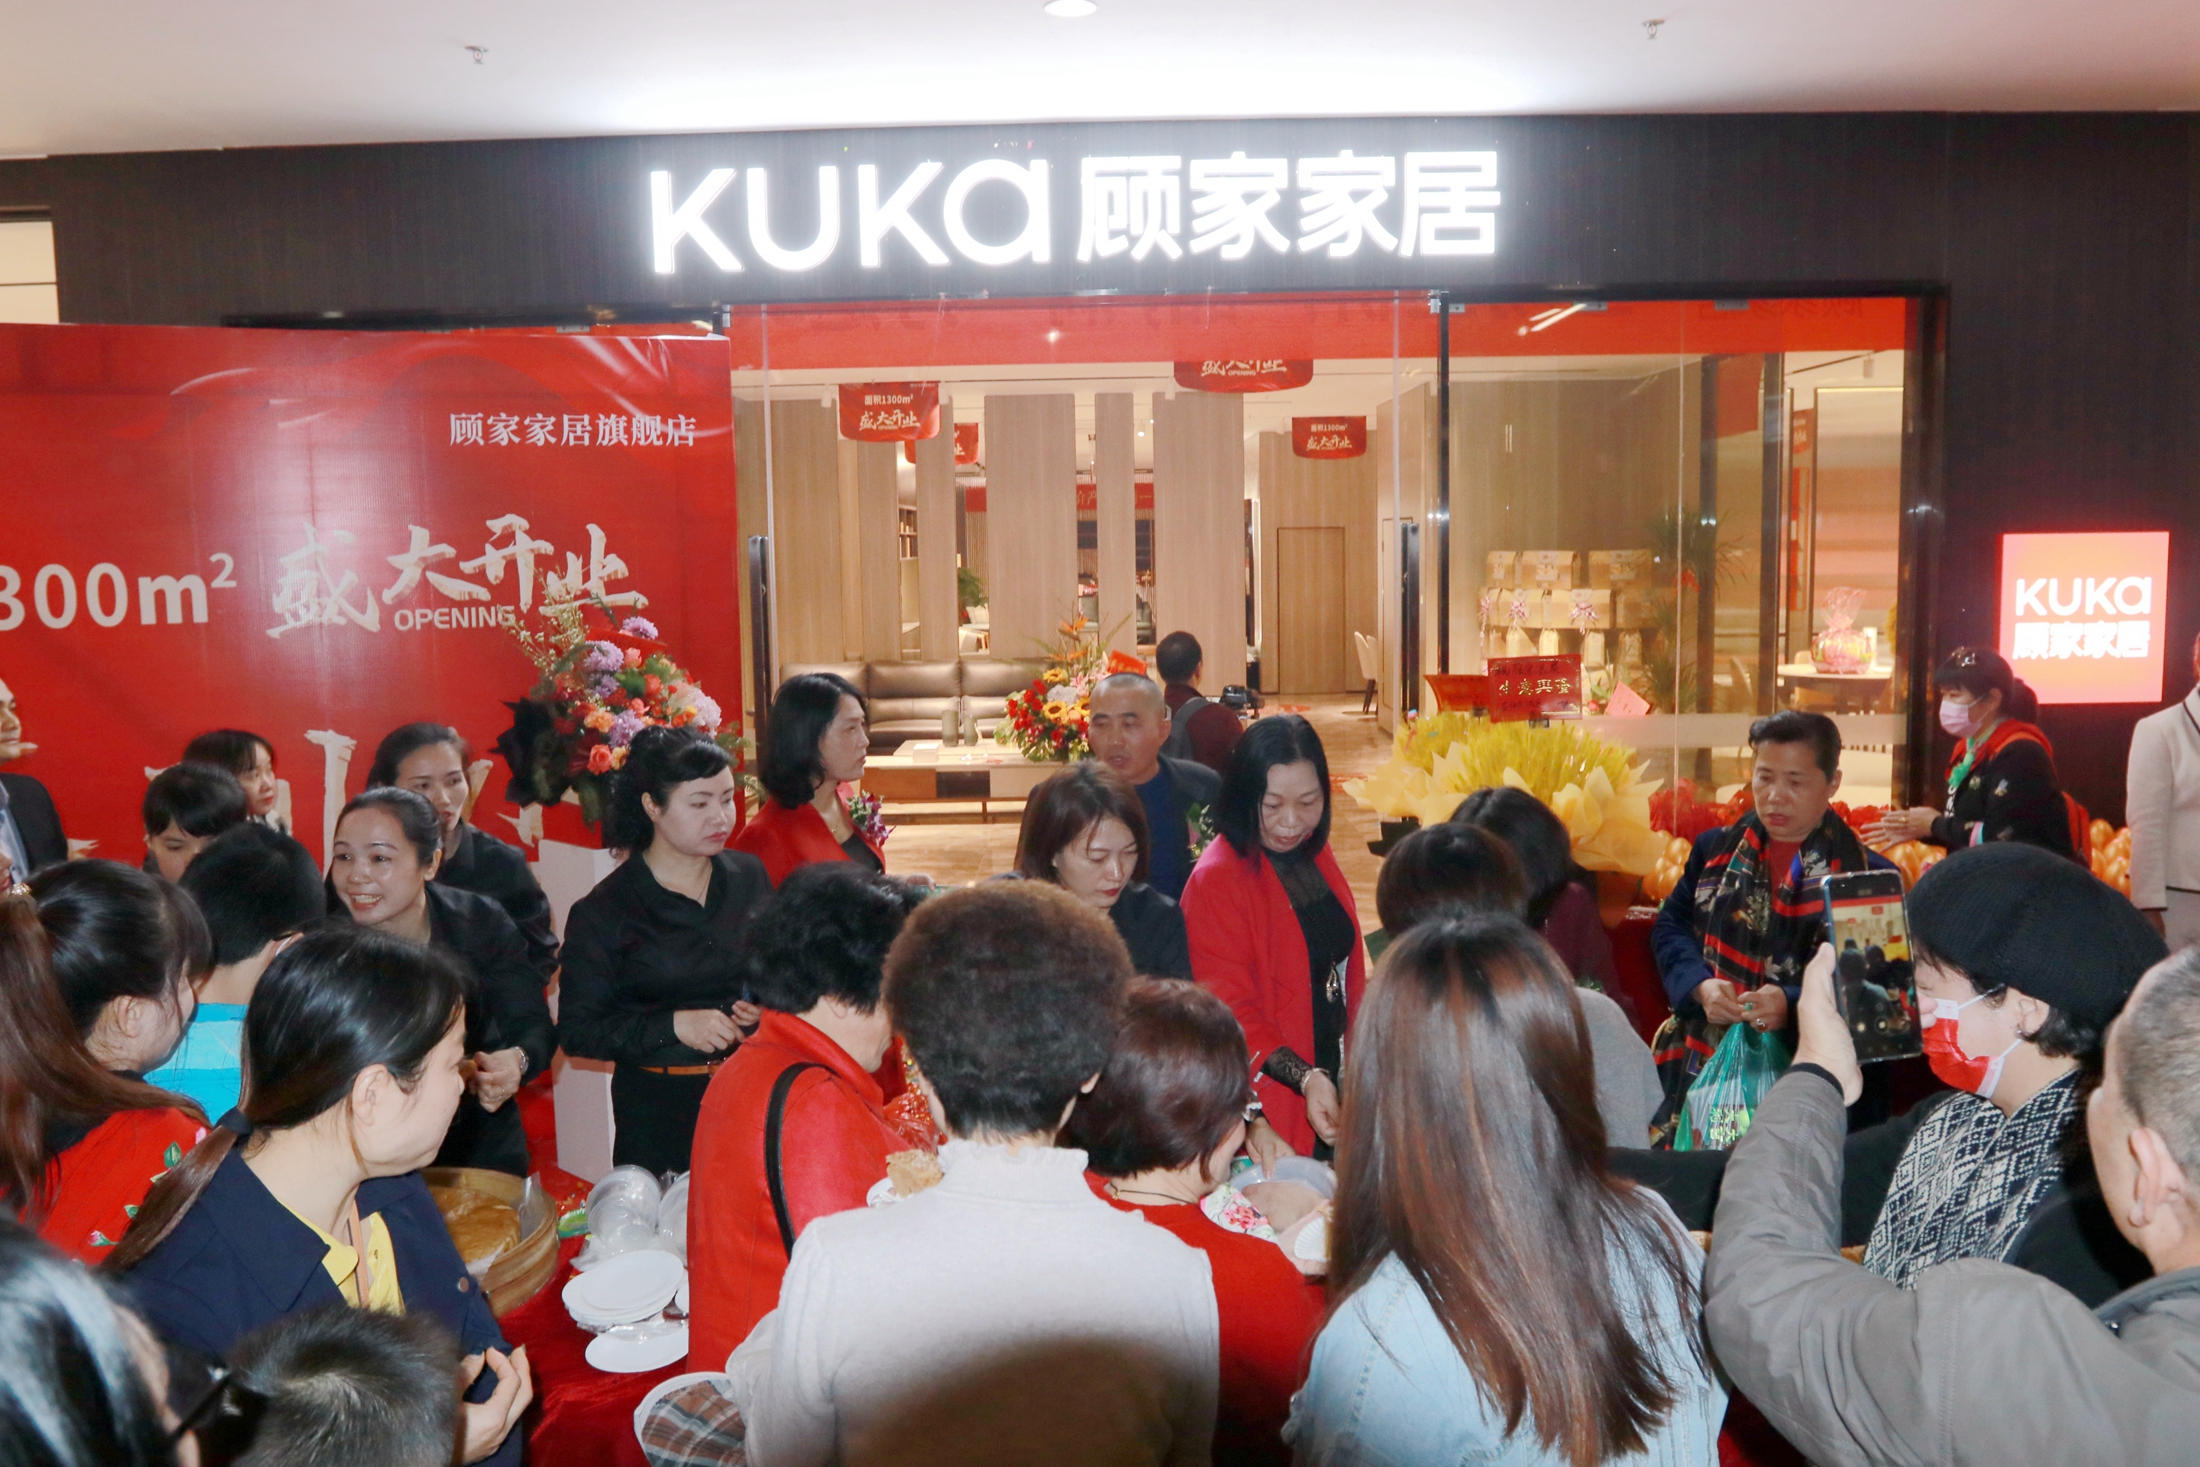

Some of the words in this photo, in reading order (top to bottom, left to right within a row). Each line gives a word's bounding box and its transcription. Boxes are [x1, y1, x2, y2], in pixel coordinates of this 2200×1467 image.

[1077, 149, 1501, 262] 顾家家居
[450, 412, 697, 447] 顾家家居旗舰店
[859, 409, 920, 431] 盛大开业
[265, 513, 650, 639] 盛大开业
[394, 605, 516, 631] OPENING
[2012, 620, 2151, 660] 顾家家居
